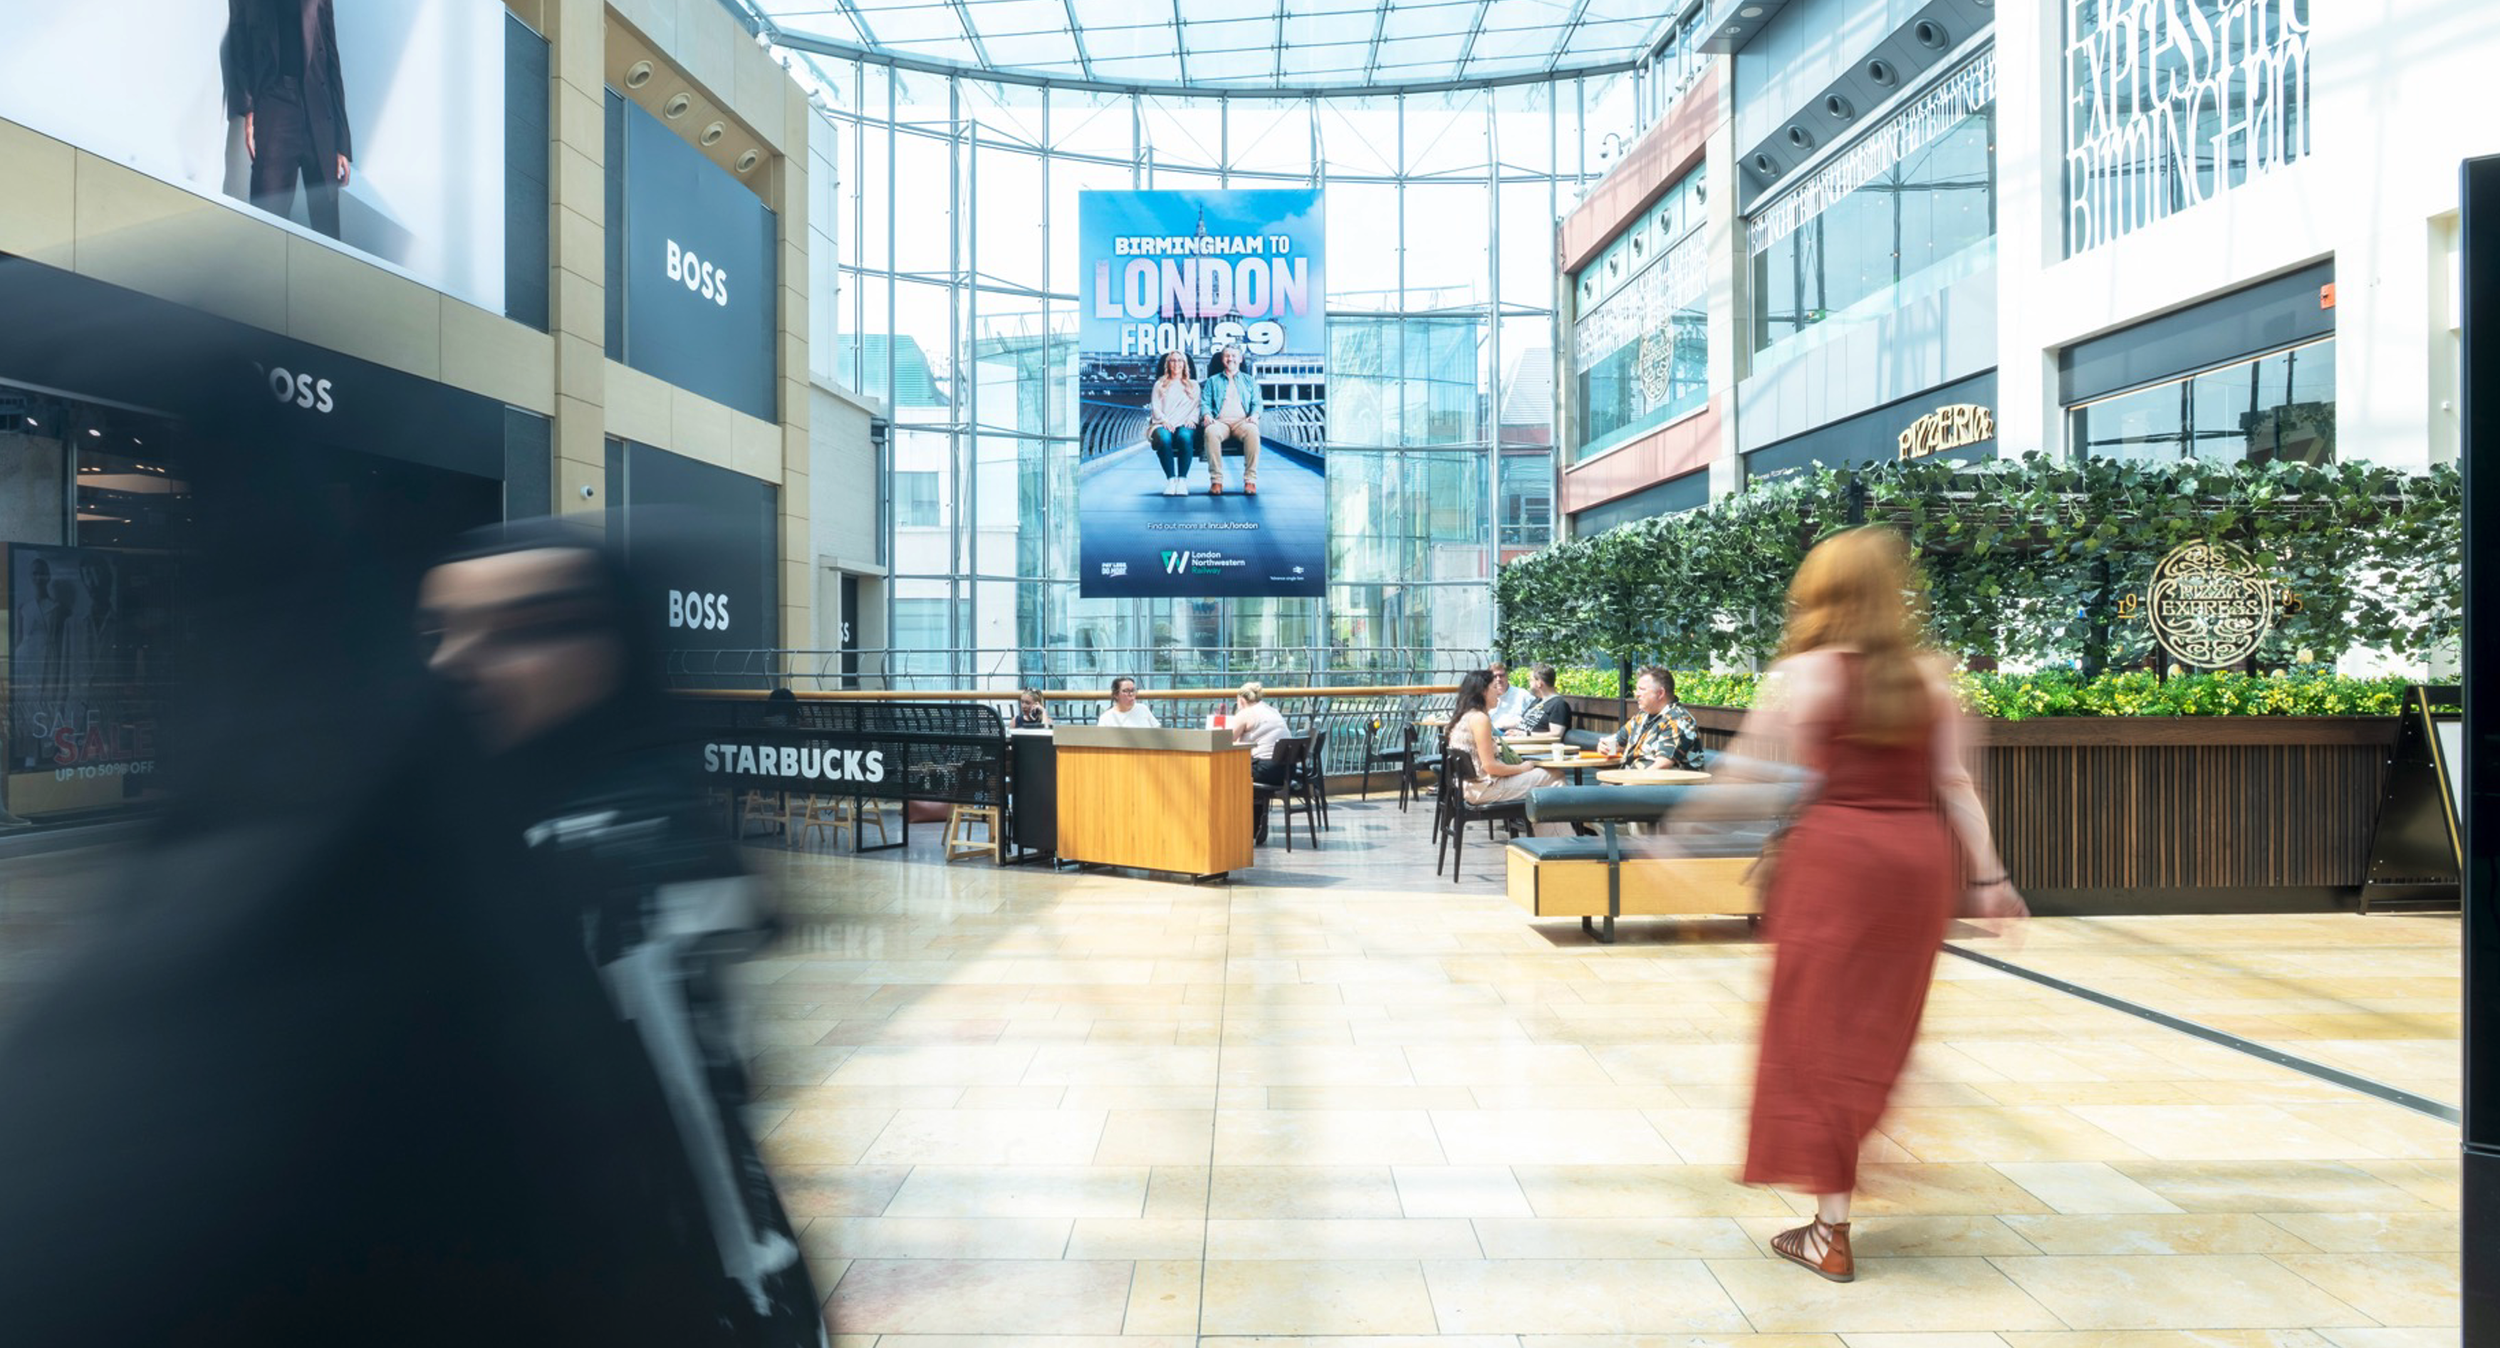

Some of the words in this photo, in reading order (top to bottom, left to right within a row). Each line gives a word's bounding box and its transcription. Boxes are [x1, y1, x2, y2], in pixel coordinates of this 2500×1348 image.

[1115, 236, 1263, 256] BIRMINGHAM
[1269, 235, 1290, 254] TO
[667, 238, 728, 307] BOSS
[1095, 257, 1308, 318] LONDON
[1120, 322, 1201, 357] FROM
[1211, 321, 1285, 356] £9
[252, 360, 334, 413] OSS
[1898, 403, 1993, 461] PIZZERIA
[1147, 522, 1162, 530] Find
[1164, 522, 1177, 530] out
[1199, 522, 1207, 530] at
[1191, 551, 1221, 559] London
[1191, 558, 1246, 567] Northwestern
[1191, 566, 1221, 575] Railway
[2117, 593, 2138, 615] 19
[2179, 583, 2241, 600] PIZZA
[669, 589, 730, 631] BOSS
[2161, 600, 2261, 616] EXPRESS
[32, 710, 101, 739] SALE
[54, 718, 156, 766] SALE
[55, 768, 74, 782] UP
[78, 766, 96, 780] TO
[98, 763, 127, 777] 50%
[130, 761, 155, 775] OFF
[704, 743, 884, 783] STARBUCKS
